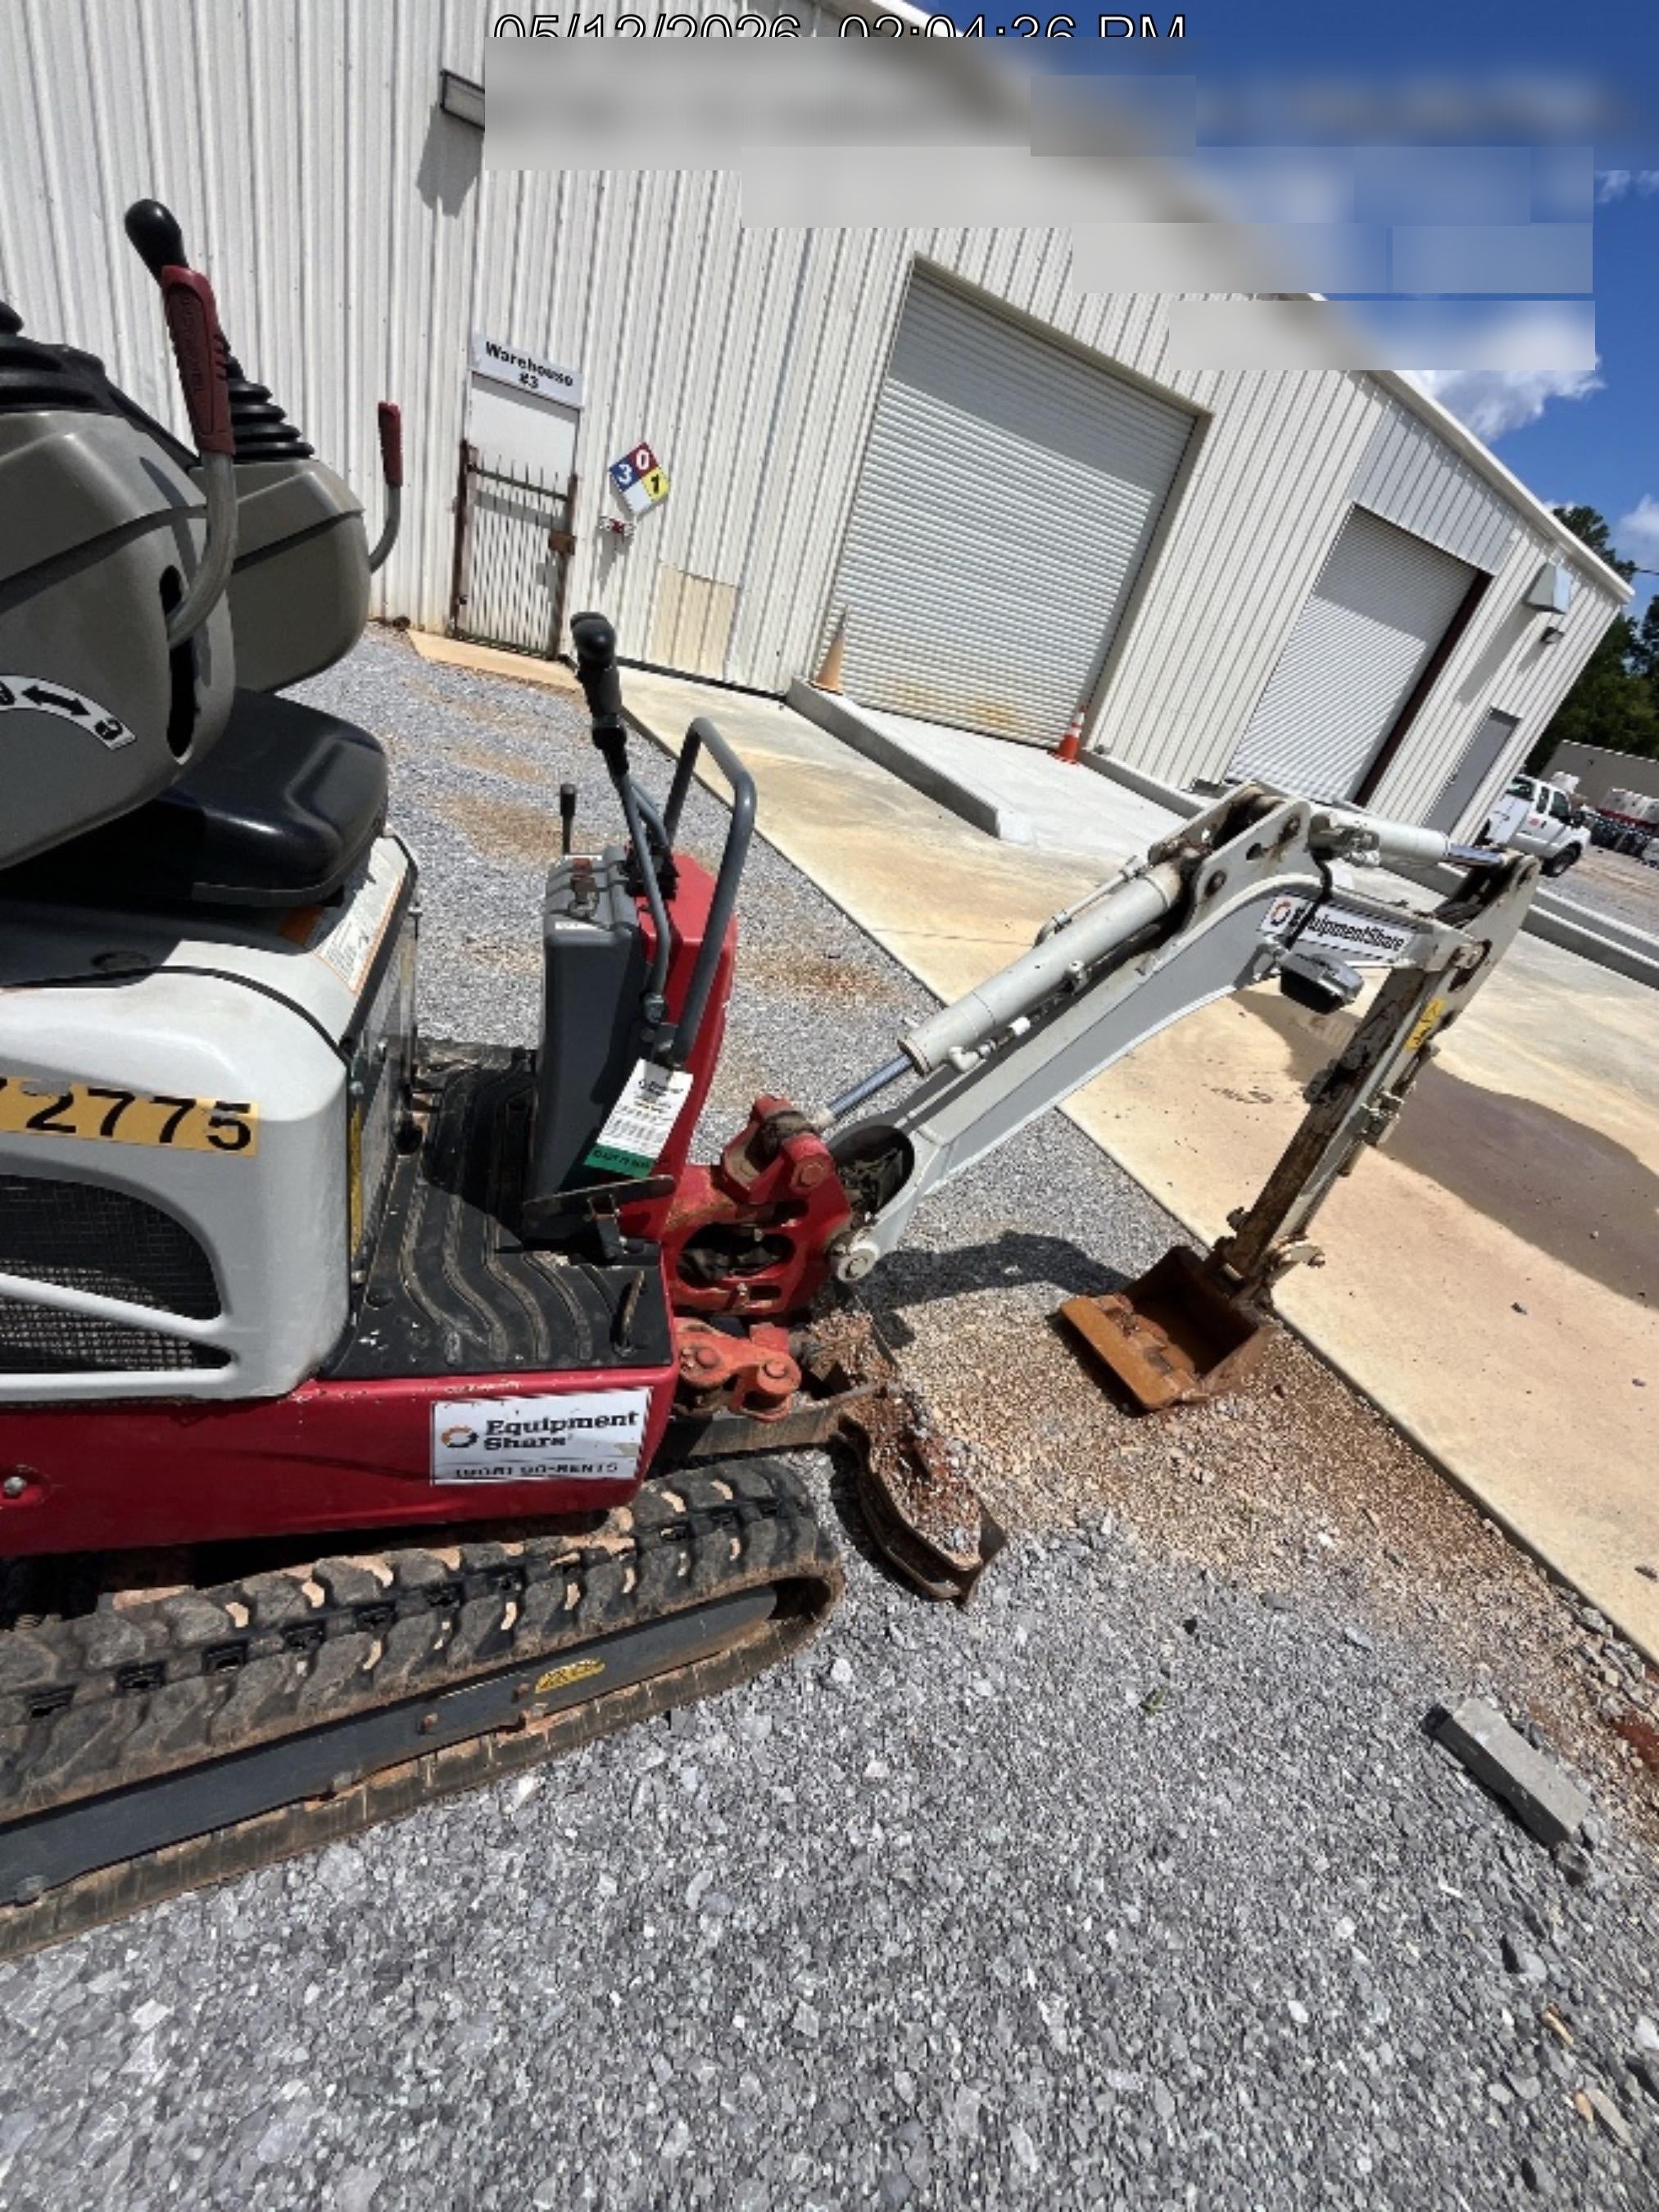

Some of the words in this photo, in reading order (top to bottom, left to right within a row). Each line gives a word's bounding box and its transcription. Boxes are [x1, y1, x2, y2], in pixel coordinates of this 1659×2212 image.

[485, 341, 573, 387] Warehouse
[636, 451, 650, 470] 0
[618, 465, 633, 483] 3
[650, 475, 660, 494] 1
[1290, 906, 1406, 952] EuipmentShare
[0, 1078, 252, 1151] 2775
[486, 1410, 640, 1436] Equipment
[483, 1437, 567, 1451] Share
